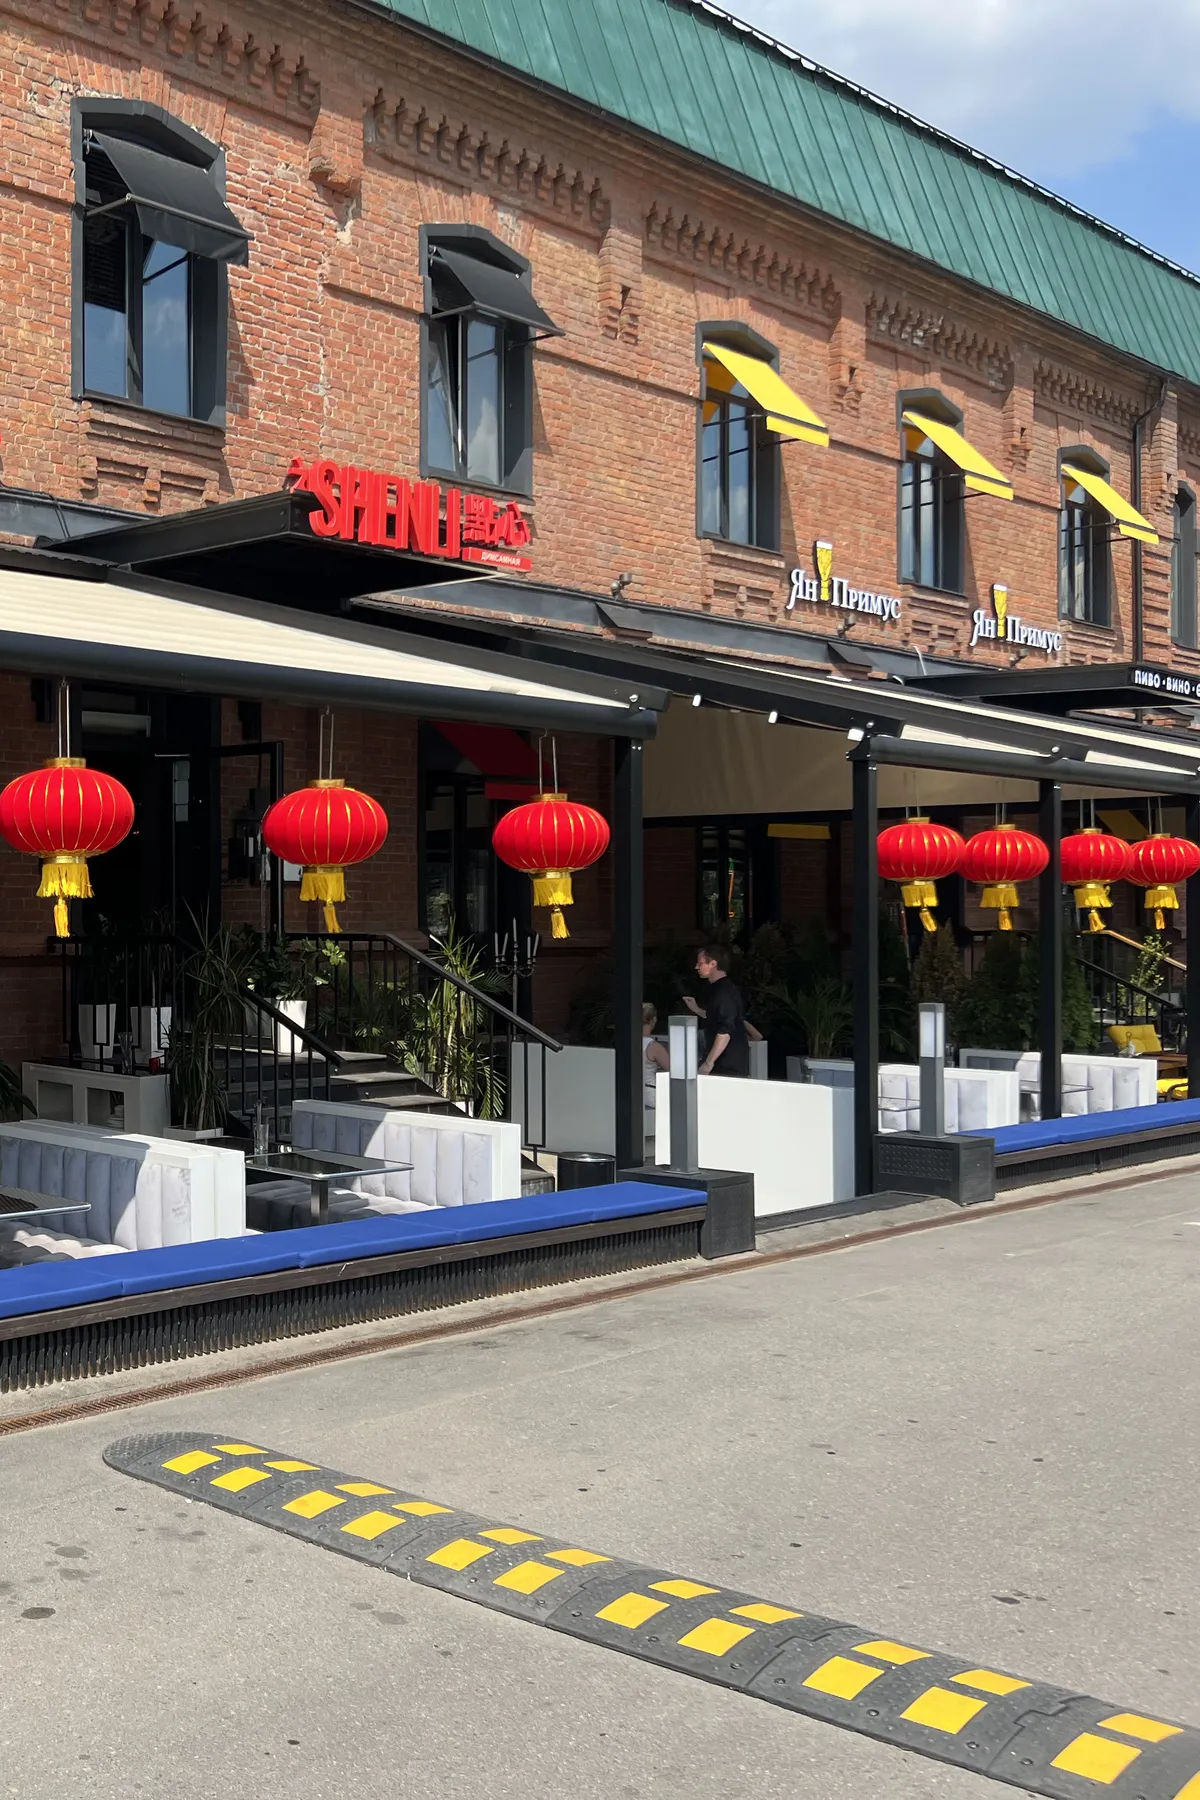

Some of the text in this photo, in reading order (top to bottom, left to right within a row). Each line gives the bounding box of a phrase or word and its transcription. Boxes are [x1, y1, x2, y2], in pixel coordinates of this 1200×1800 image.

[308, 459, 461, 559] SHENLI
[463, 494, 532, 546] 點心
[481, 551, 521, 567] ДИМСАМНАЯ
[786, 568, 901, 621] Ян Примус
[969, 609, 1062, 654] Ян Примус
